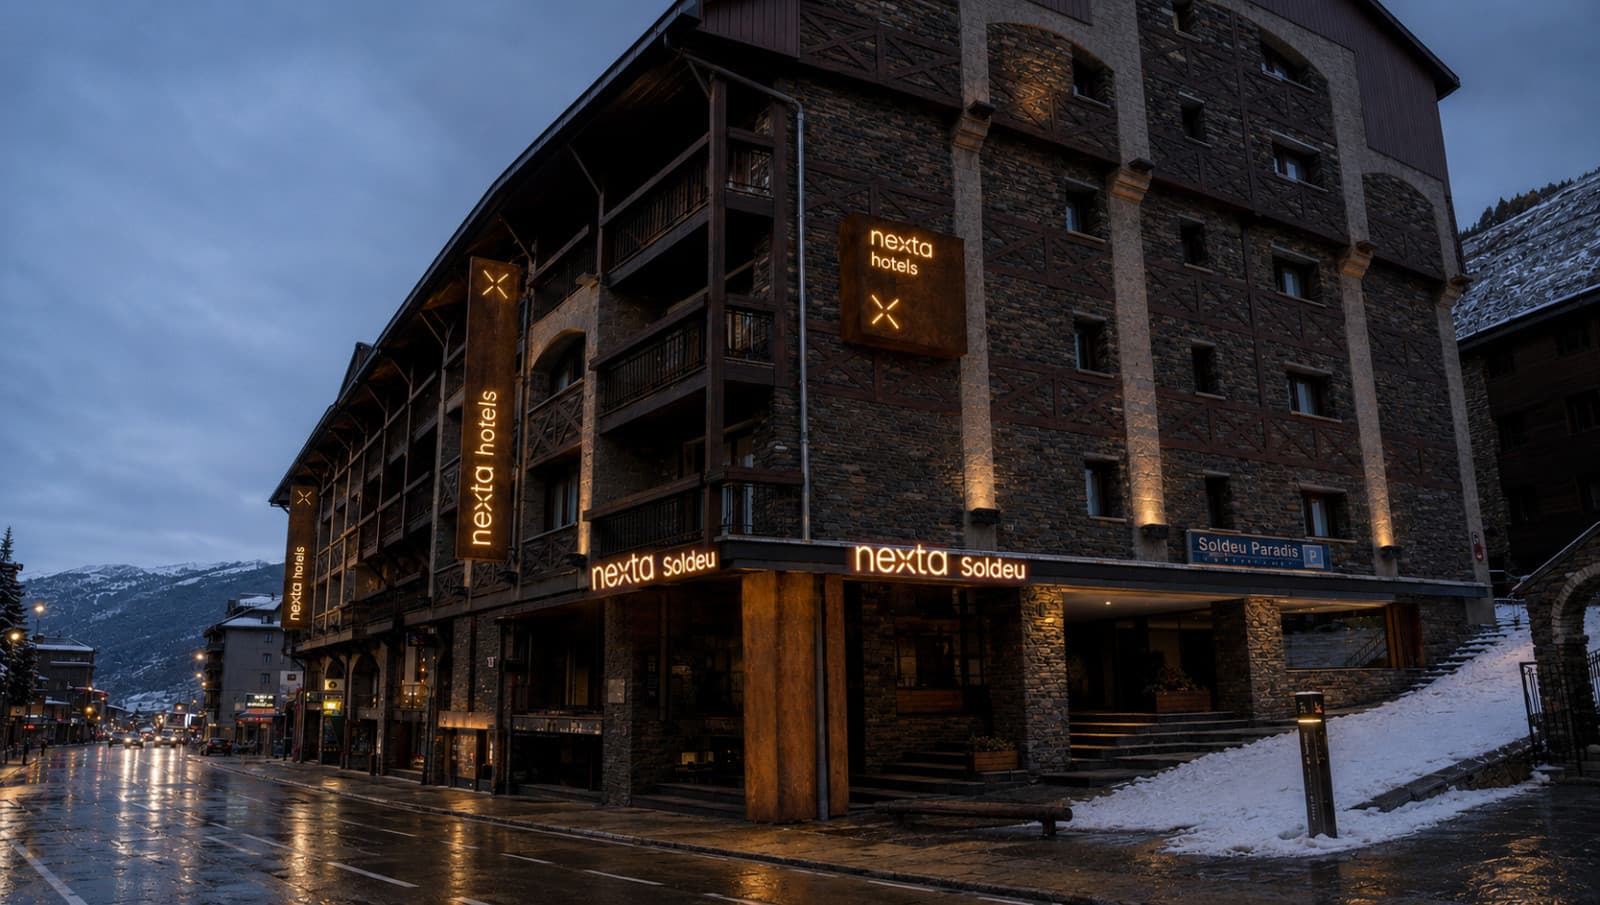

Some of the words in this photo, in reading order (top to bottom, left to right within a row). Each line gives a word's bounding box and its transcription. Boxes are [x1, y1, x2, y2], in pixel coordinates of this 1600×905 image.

[870, 229, 933, 259] nexta
[871, 251, 919, 276] hotels
[474, 390, 498, 457] hotels
[470, 465, 495, 547] nexta
[292, 546, 305, 579] hotels
[854, 543, 949, 578] nexta
[960, 556, 1027, 581] Soldeu
[1198, 536, 1247, 555] Soldeu
[1251, 541, 1299, 558] Paradis
[591, 553, 656, 592] nexta
[662, 549, 717, 579] Soldeu
[290, 582, 303, 622] nexta
